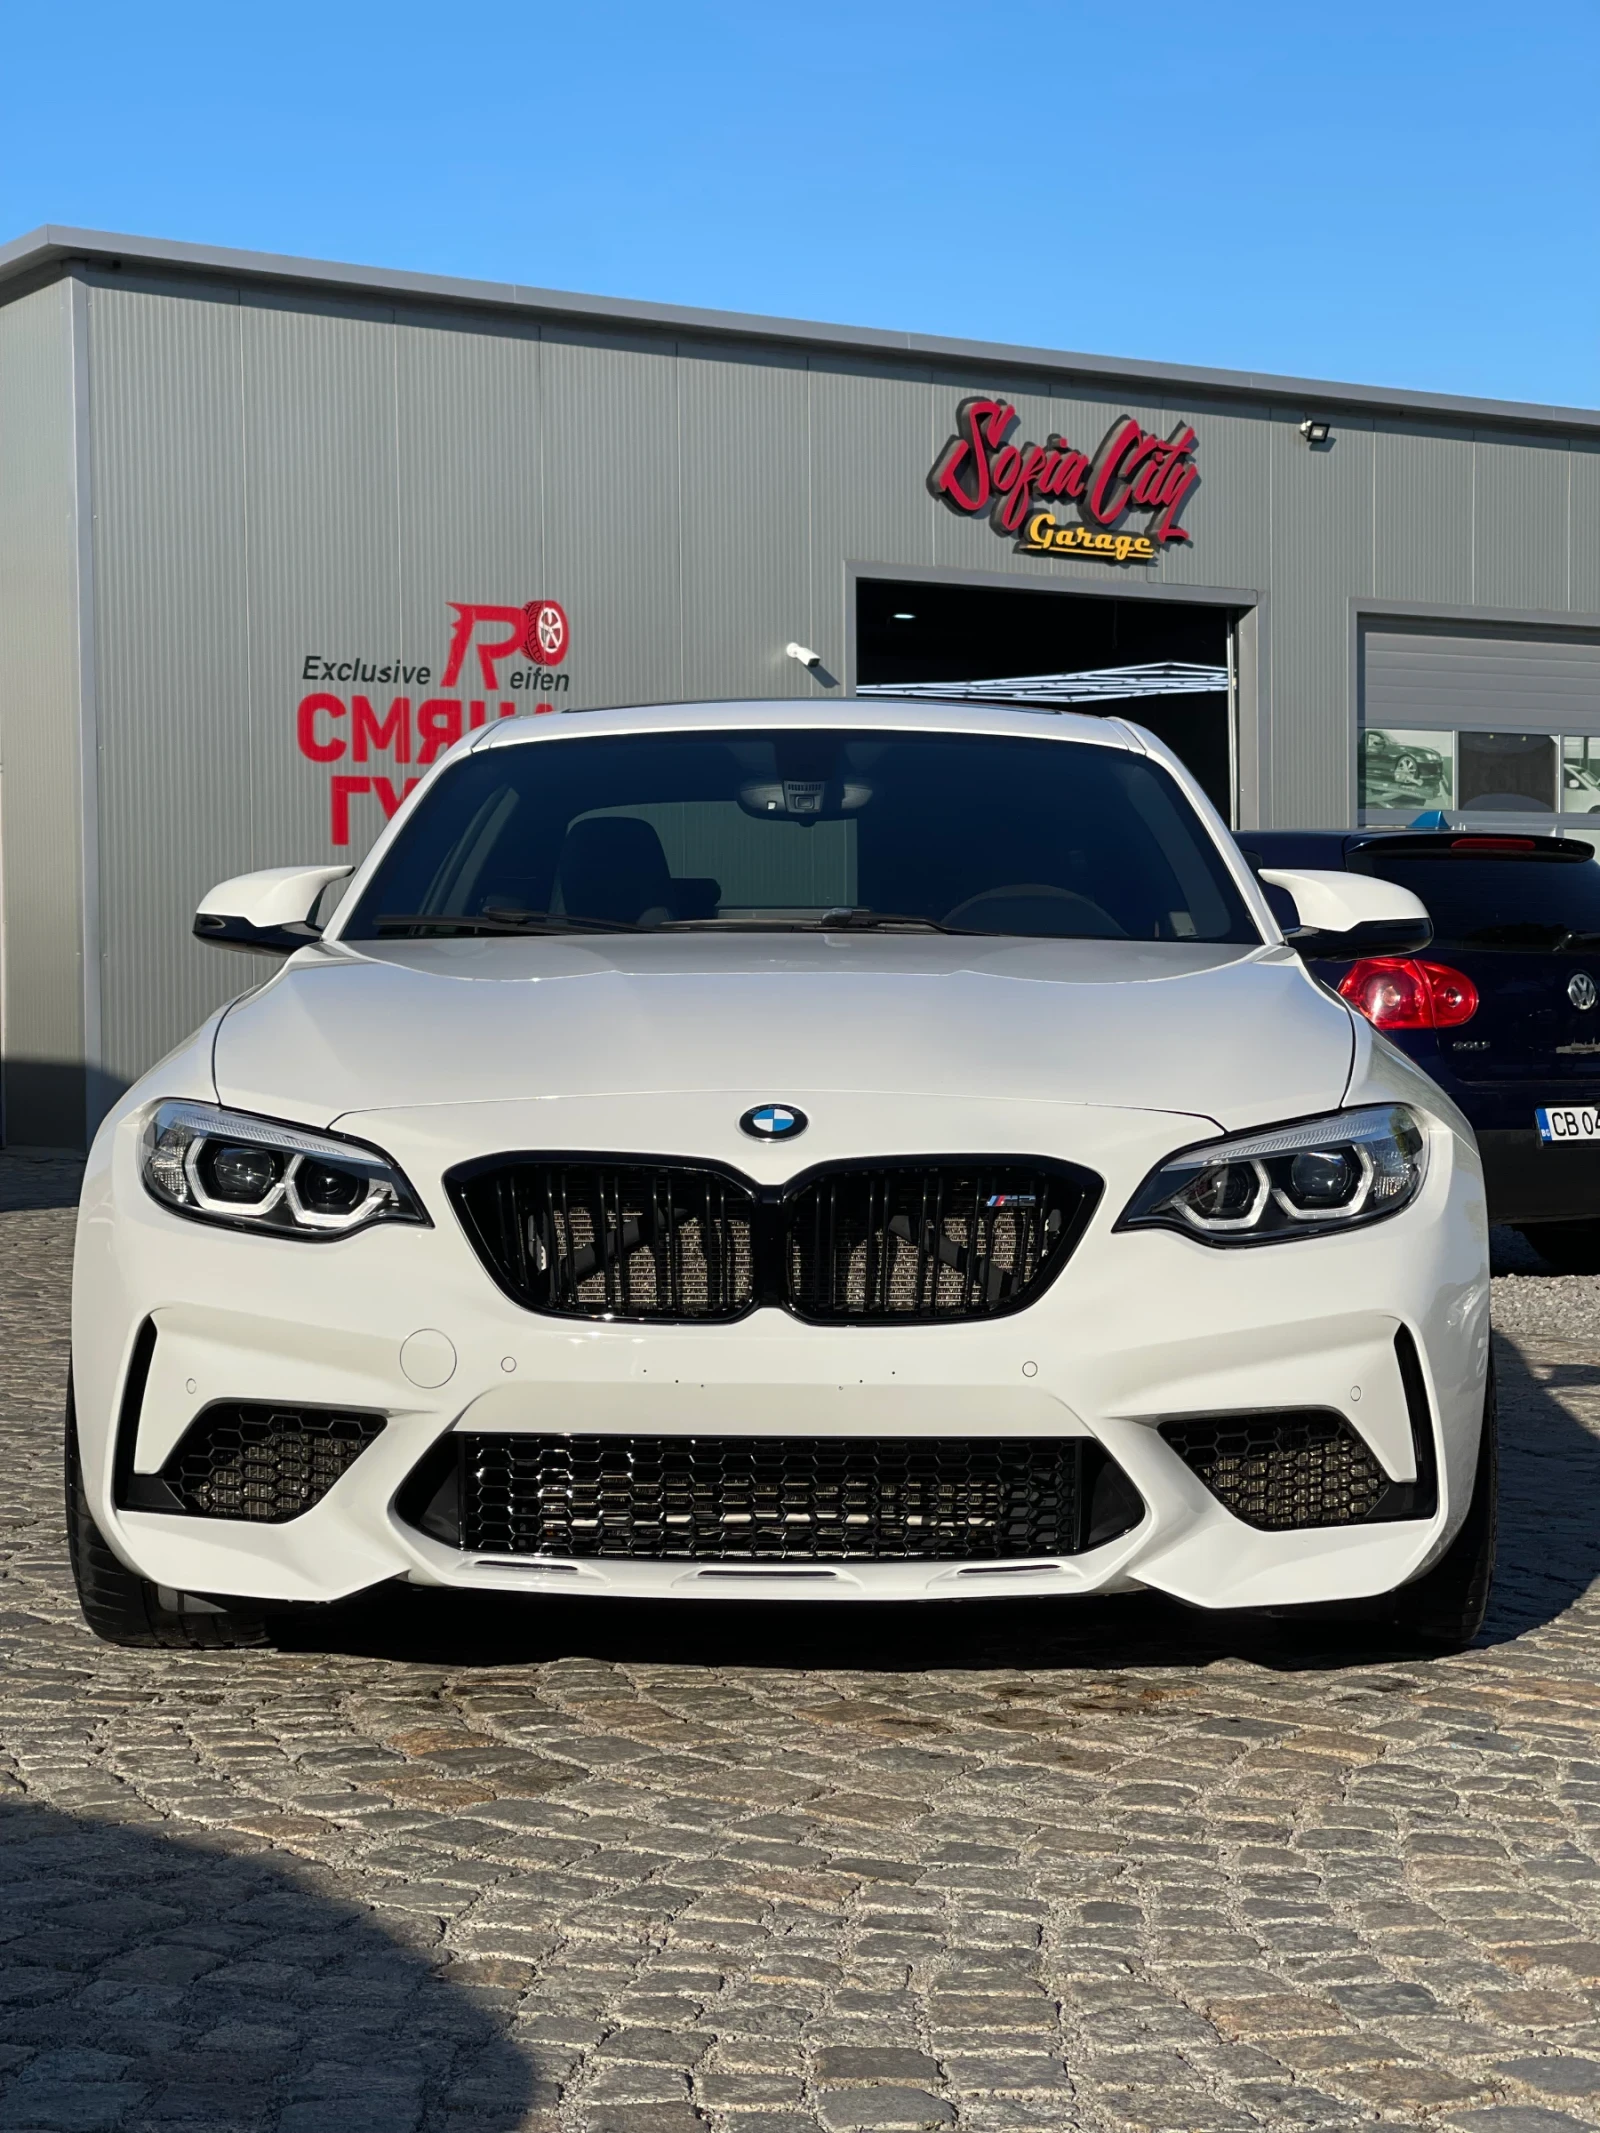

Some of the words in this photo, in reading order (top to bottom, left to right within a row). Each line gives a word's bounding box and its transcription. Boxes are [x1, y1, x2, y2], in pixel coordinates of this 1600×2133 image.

[939, 400, 1089, 531] Sofia
[1090, 418, 1198, 543] City
[1029, 513, 1154, 560] Garage
[301, 654, 431, 685] Exclusive
[296, 692, 554, 765] СМЯ
